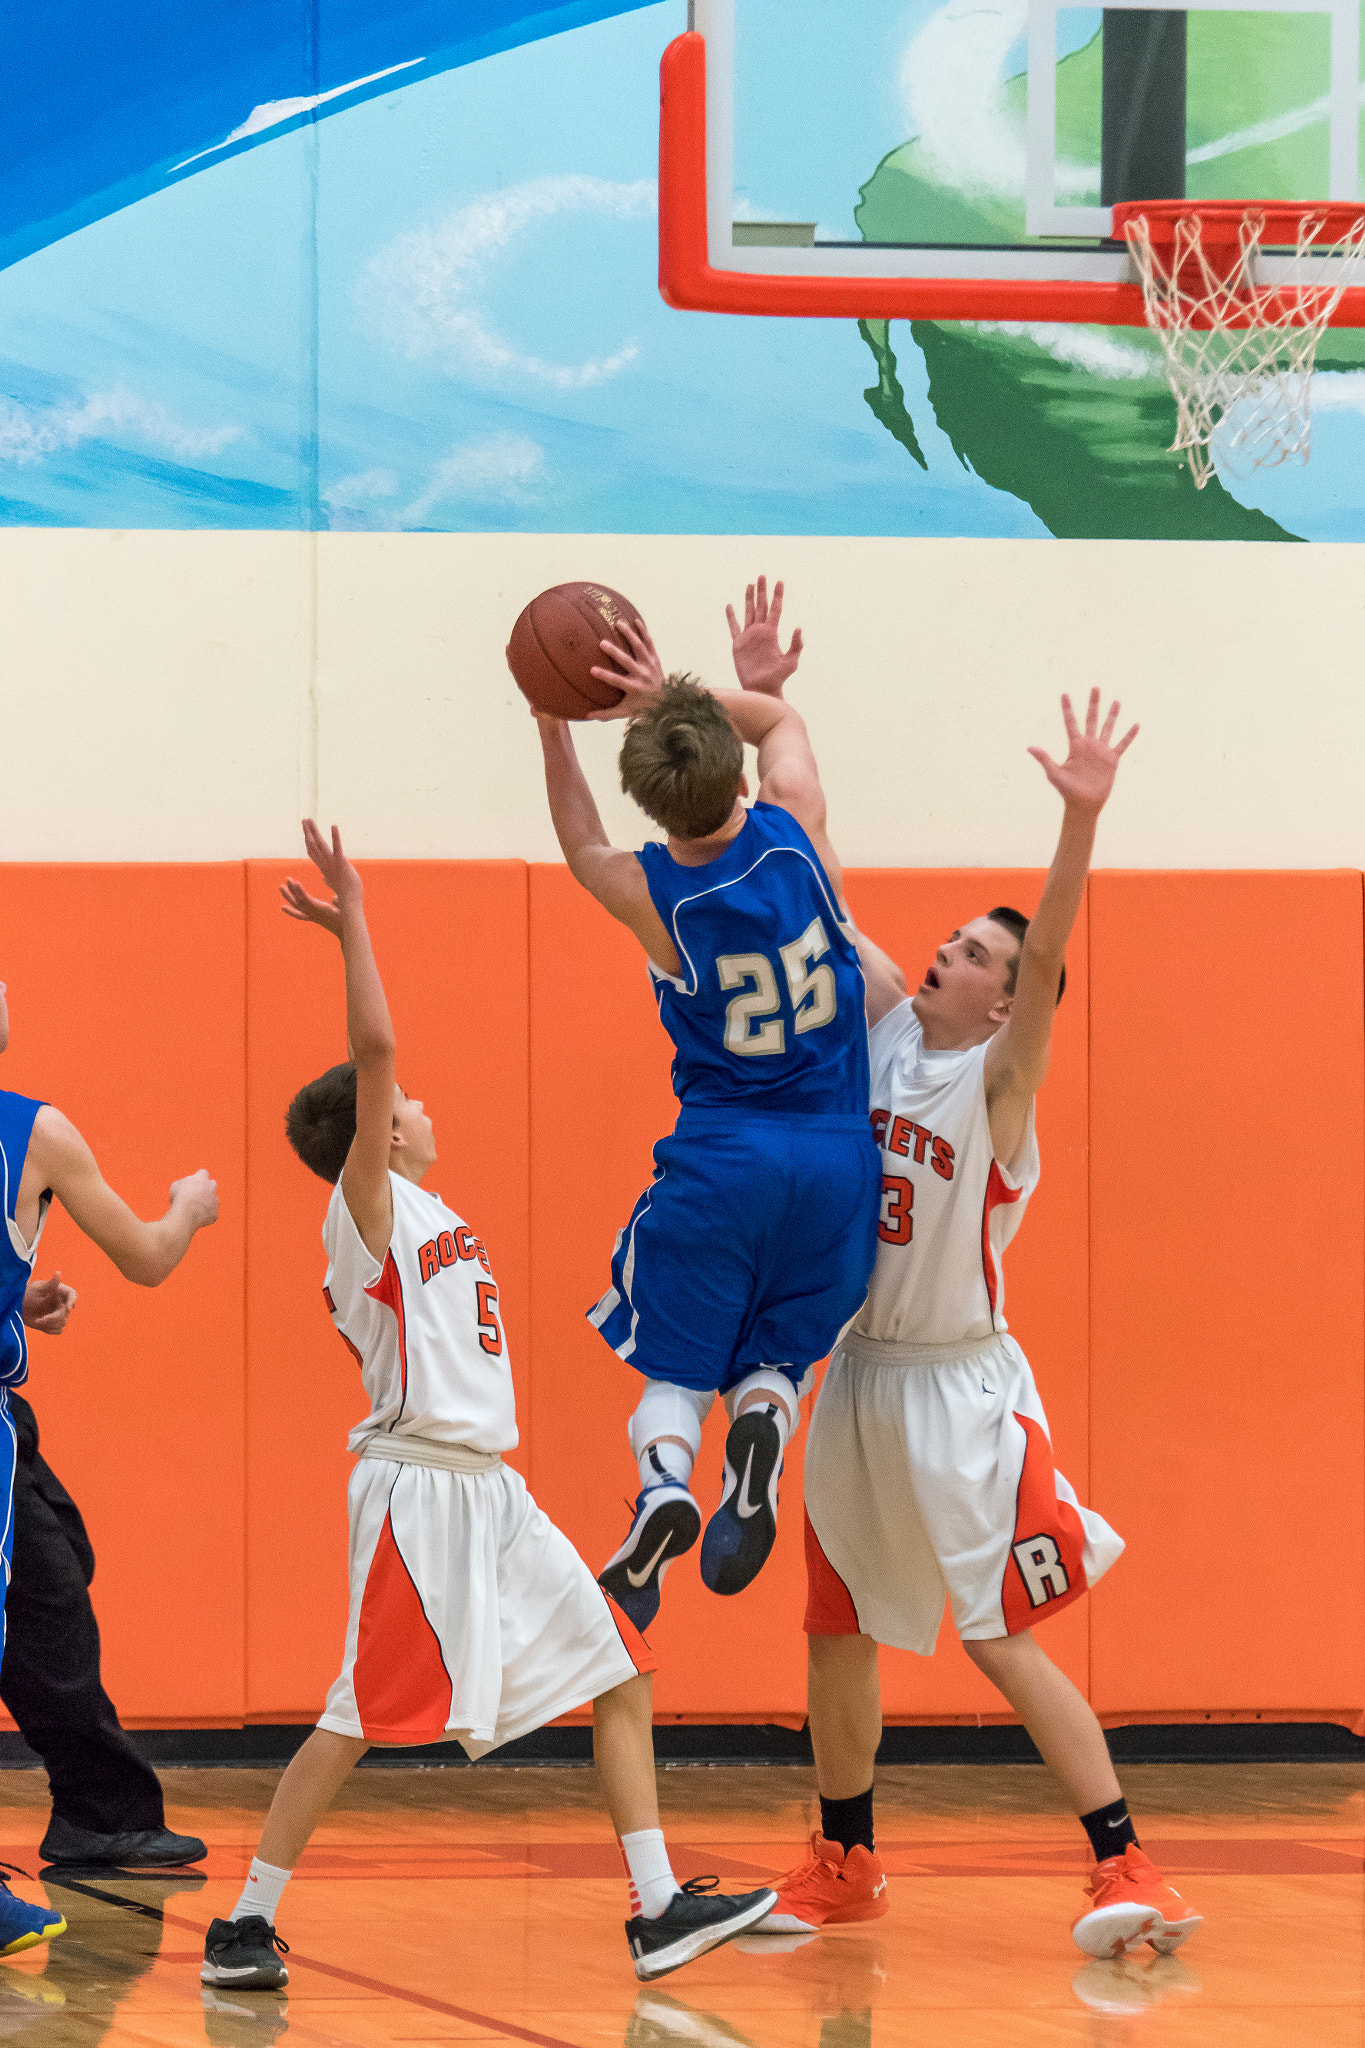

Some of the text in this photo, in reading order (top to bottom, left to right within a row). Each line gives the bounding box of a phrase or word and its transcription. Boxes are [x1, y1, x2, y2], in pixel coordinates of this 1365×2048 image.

[716, 916, 838, 1057] 25
[475, 1280, 503, 1357] 5
[1010, 1532, 1071, 1611] R
